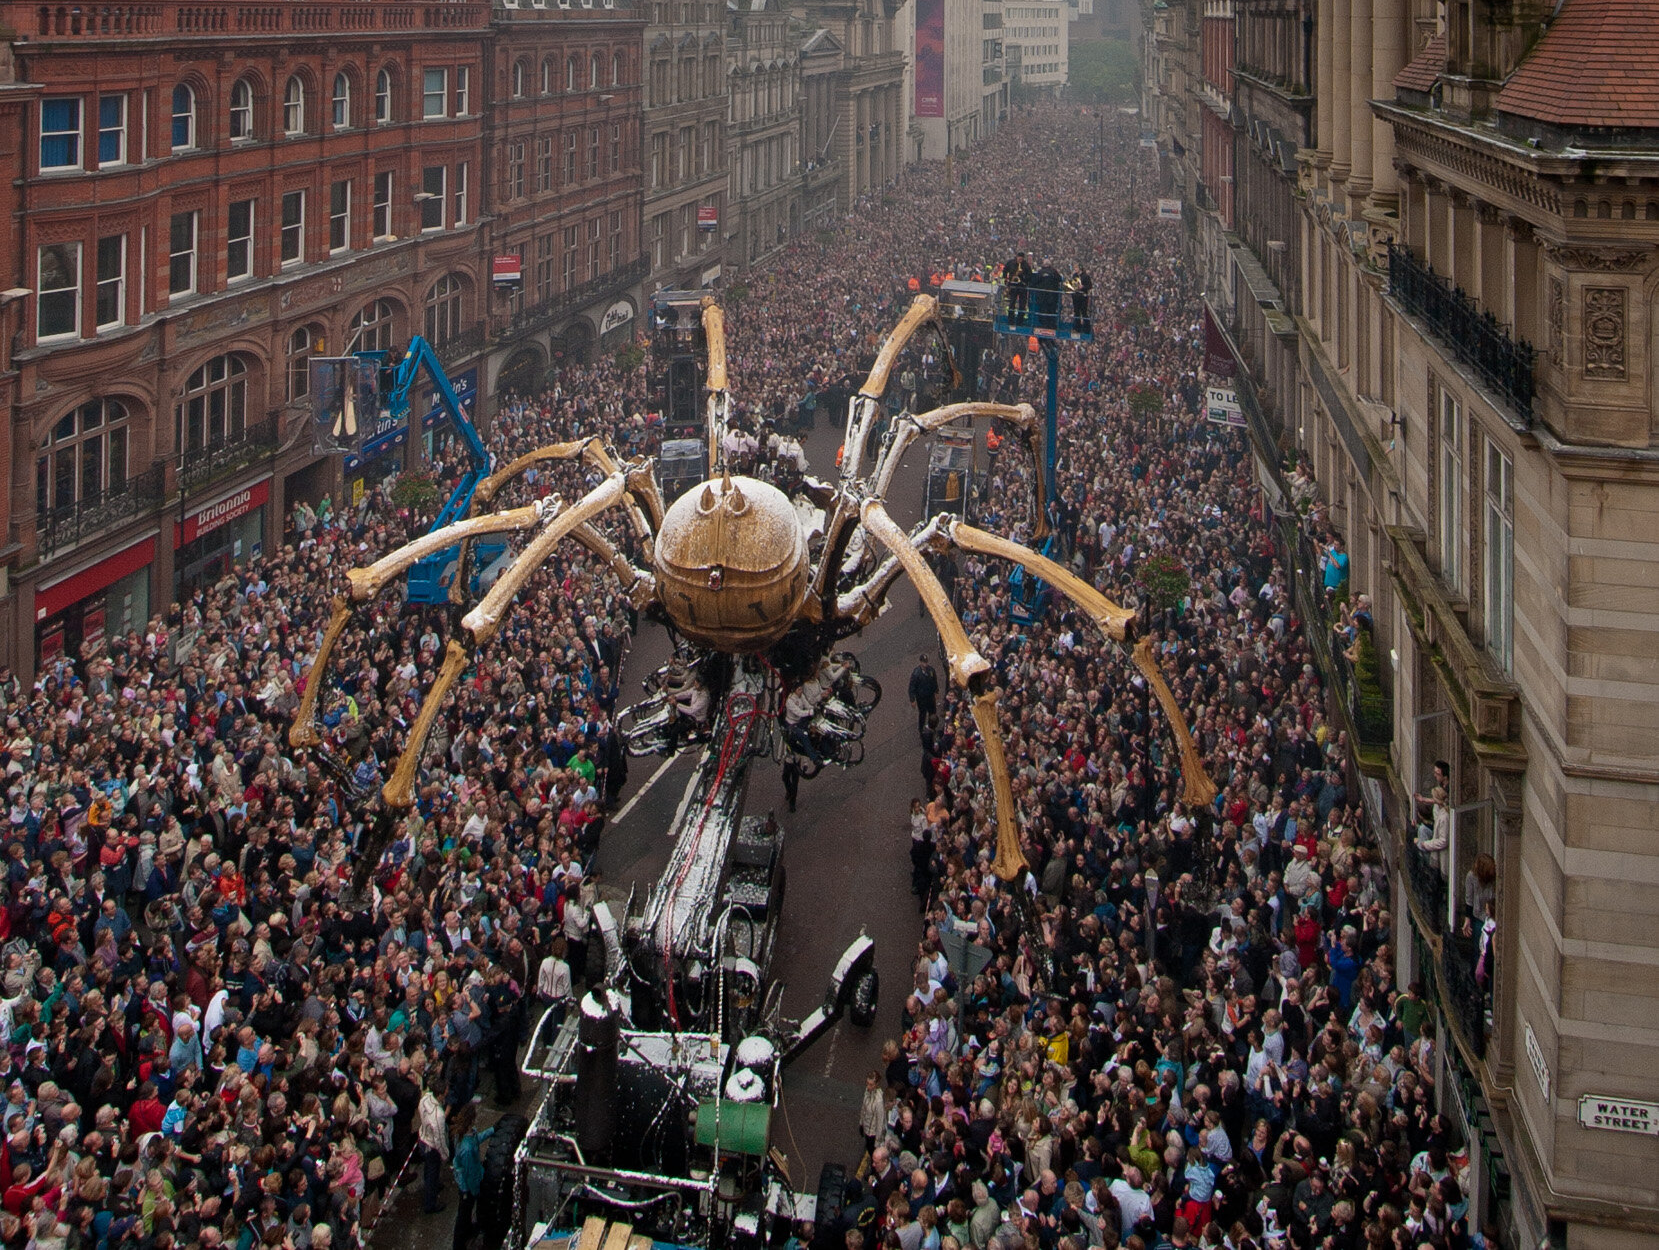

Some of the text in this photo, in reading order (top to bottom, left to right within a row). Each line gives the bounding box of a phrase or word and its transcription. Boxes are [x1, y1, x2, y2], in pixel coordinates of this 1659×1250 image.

[432, 379, 467, 406] Min's
[1210, 391, 1239, 404] TO LE
[198, 491, 251, 526] Britannia
[196, 504, 249, 537] BUILDING SOCIETY
[1597, 1103, 1648, 1118] WATER
[1594, 1115, 1650, 1130] STREET
